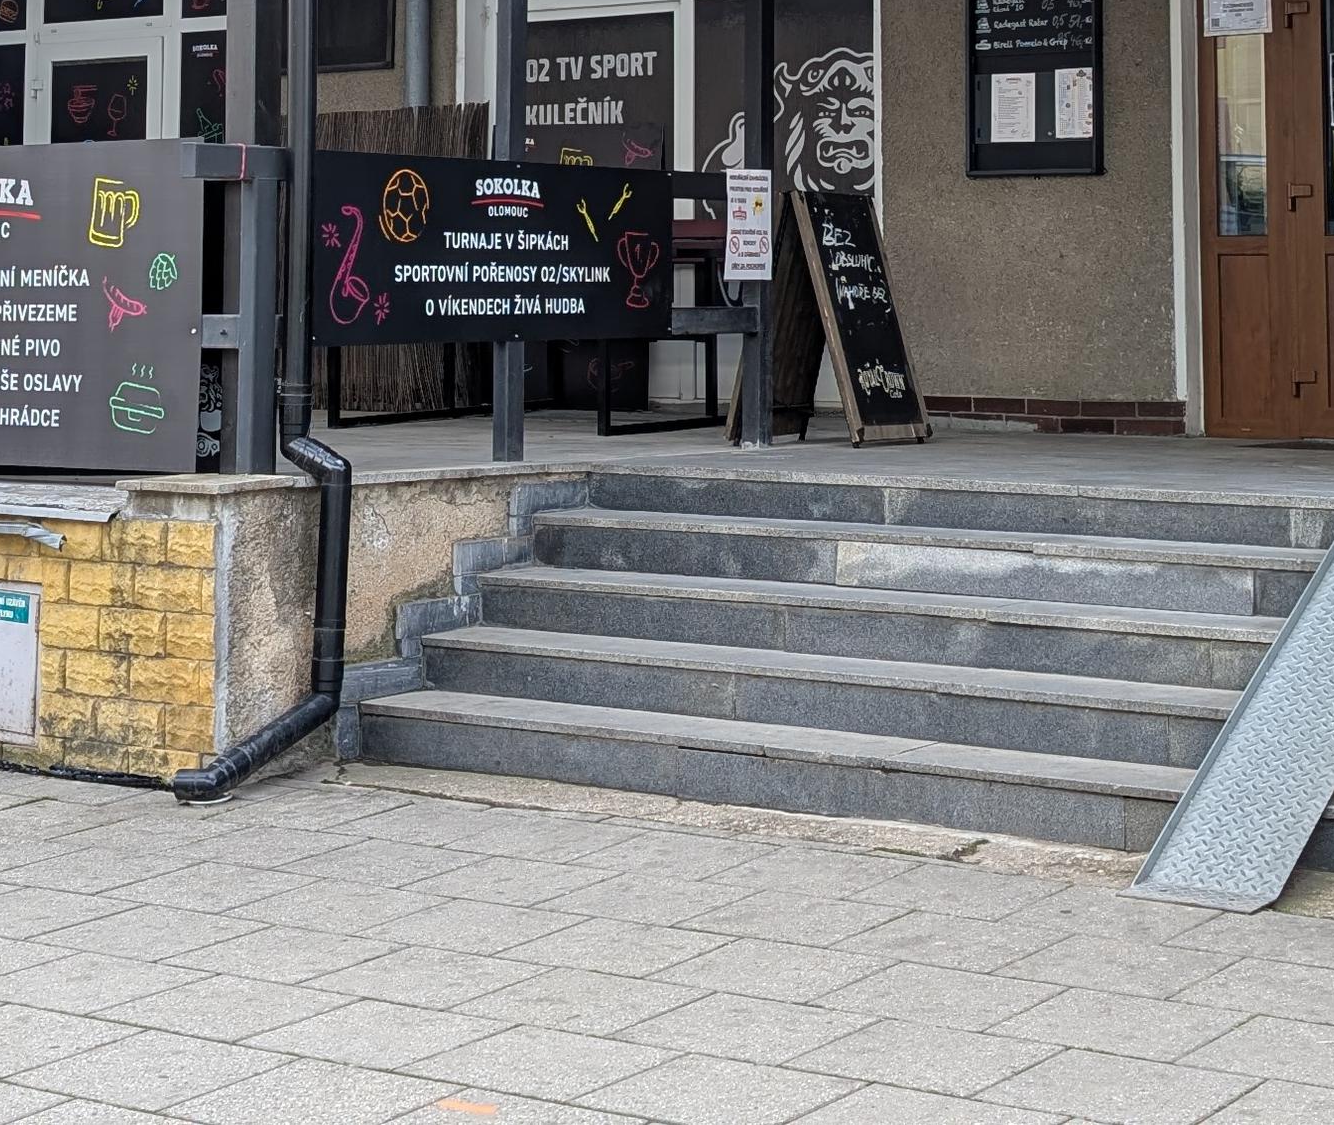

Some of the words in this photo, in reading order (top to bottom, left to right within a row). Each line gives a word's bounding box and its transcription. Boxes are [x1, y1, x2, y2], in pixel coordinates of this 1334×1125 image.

[556, 56, 584, 81] TV
[590, 51, 658, 79] SPORT
[525, 96, 624, 125] KULEČNÍK
[475, 178, 541, 199] SOKOLKA
[488, 205, 529, 217] OLOMOUC
[443, 232, 502, 250] TURNAJE
[505, 233, 514, 249] V
[518, 230, 569, 251] ŠIPKÁCH
[20, 265, 90, 287] MENÍČKA
[394, 262, 469, 283] SPORTOVNÍ
[473, 262, 537, 283] POŘENOSY
[425, 299, 434, 316] O
[439, 295, 510, 316] VÍKENDECH
[514, 295, 541, 315] ŽIVÁ
[545, 298, 585, 315] HUDBA
[25, 339, 61, 357] PIVO
[23, 374, 83, 392] OSLAVY
